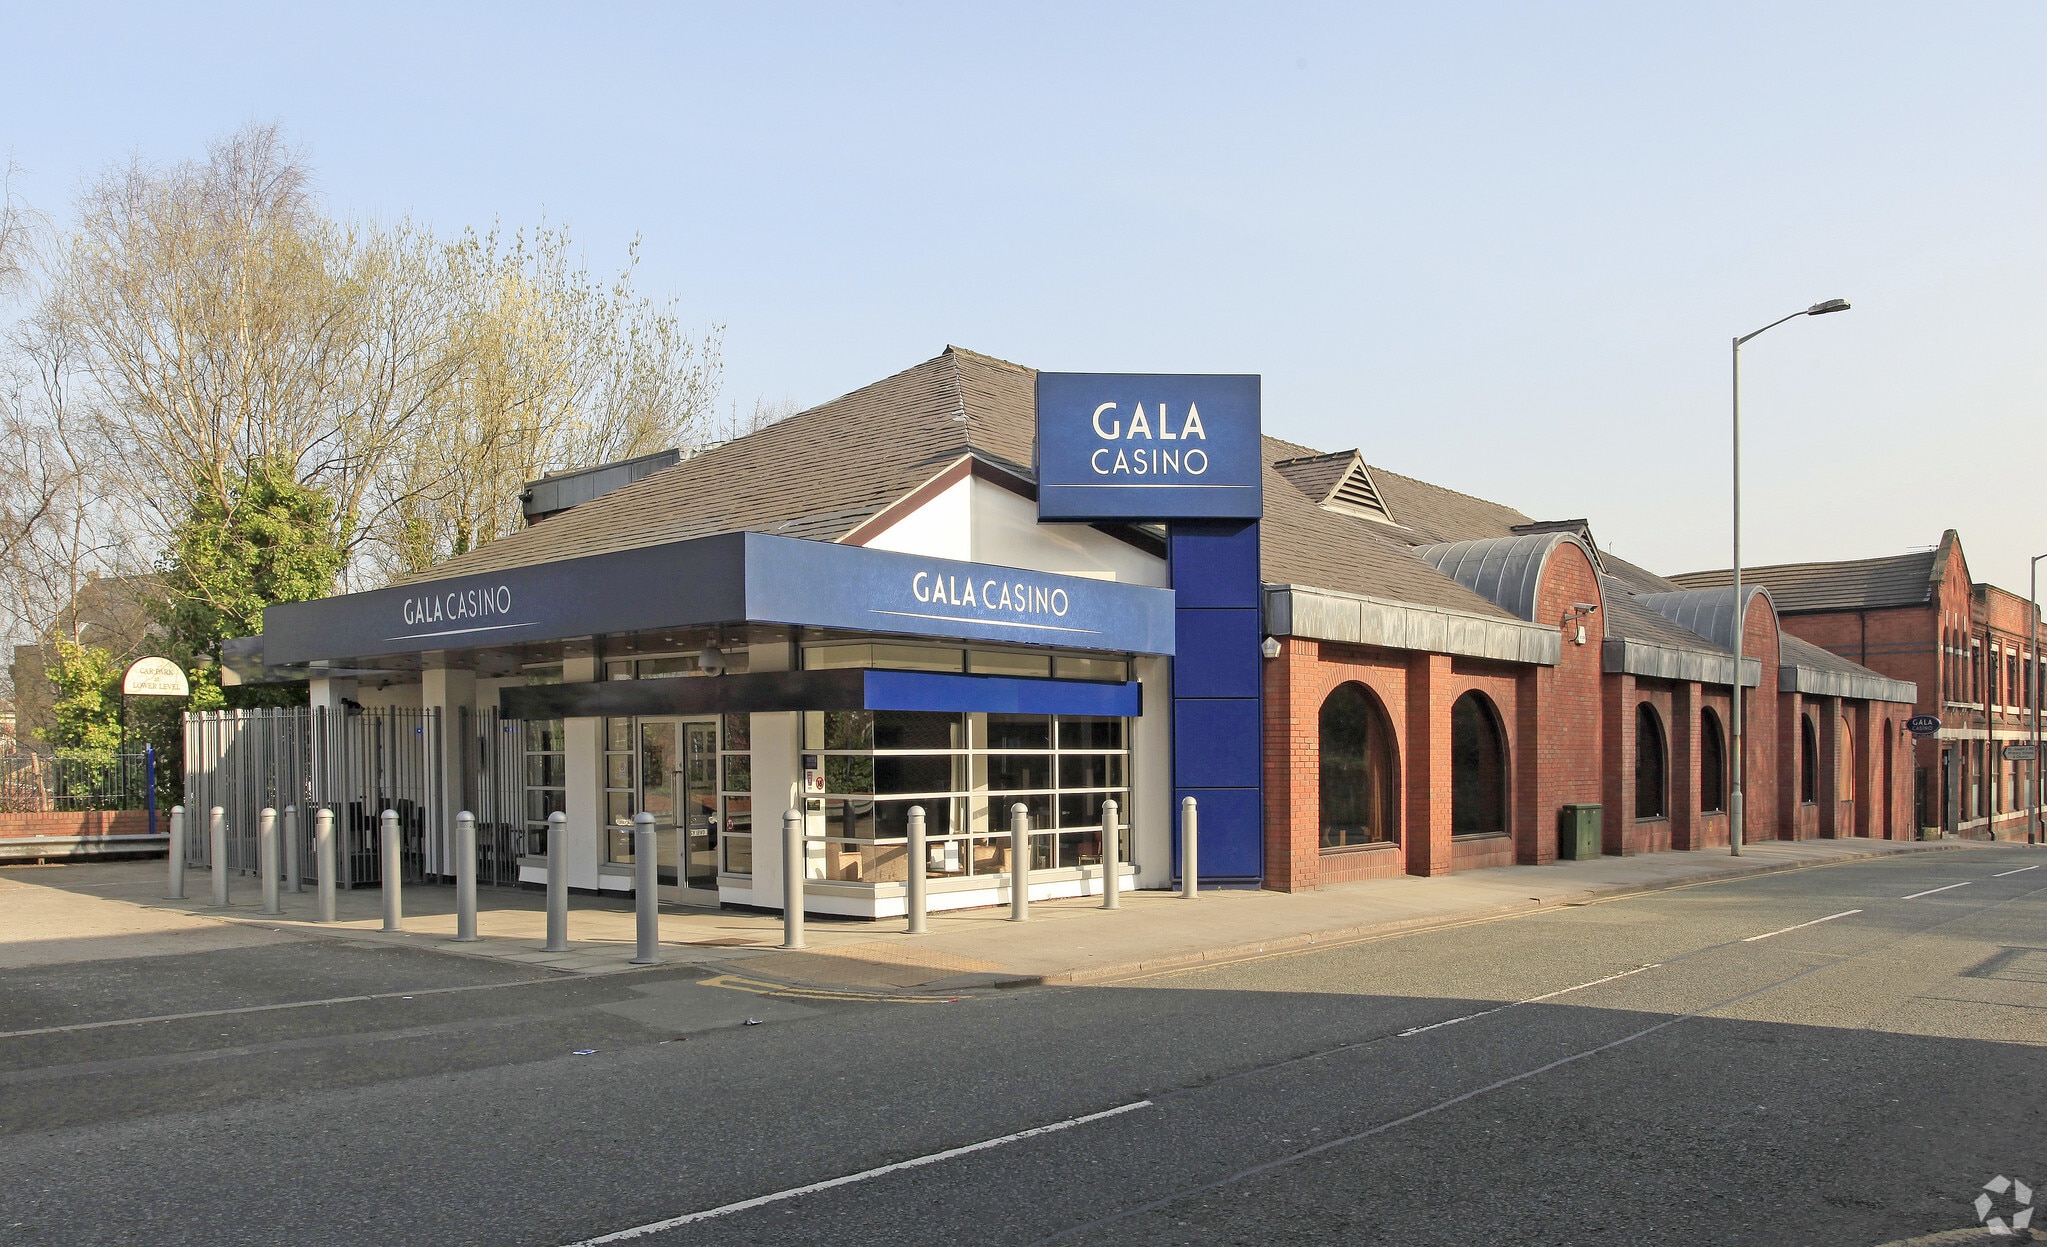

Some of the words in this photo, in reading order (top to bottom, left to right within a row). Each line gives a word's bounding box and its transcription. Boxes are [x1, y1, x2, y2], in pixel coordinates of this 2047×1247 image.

[1092, 401, 1207, 440] GALA
[1091, 448, 1208, 475] CASINO
[404, 595, 443, 625] GALA
[446, 585, 511, 620] CASINO
[912, 571, 977, 607] GALA
[982, 580, 1069, 617] CASINO
[132, 682, 157, 690] LOWER
[159, 683, 181, 691] LEVEL
[139, 667, 154, 675] CAR
[155, 668, 174, 676] PARK
